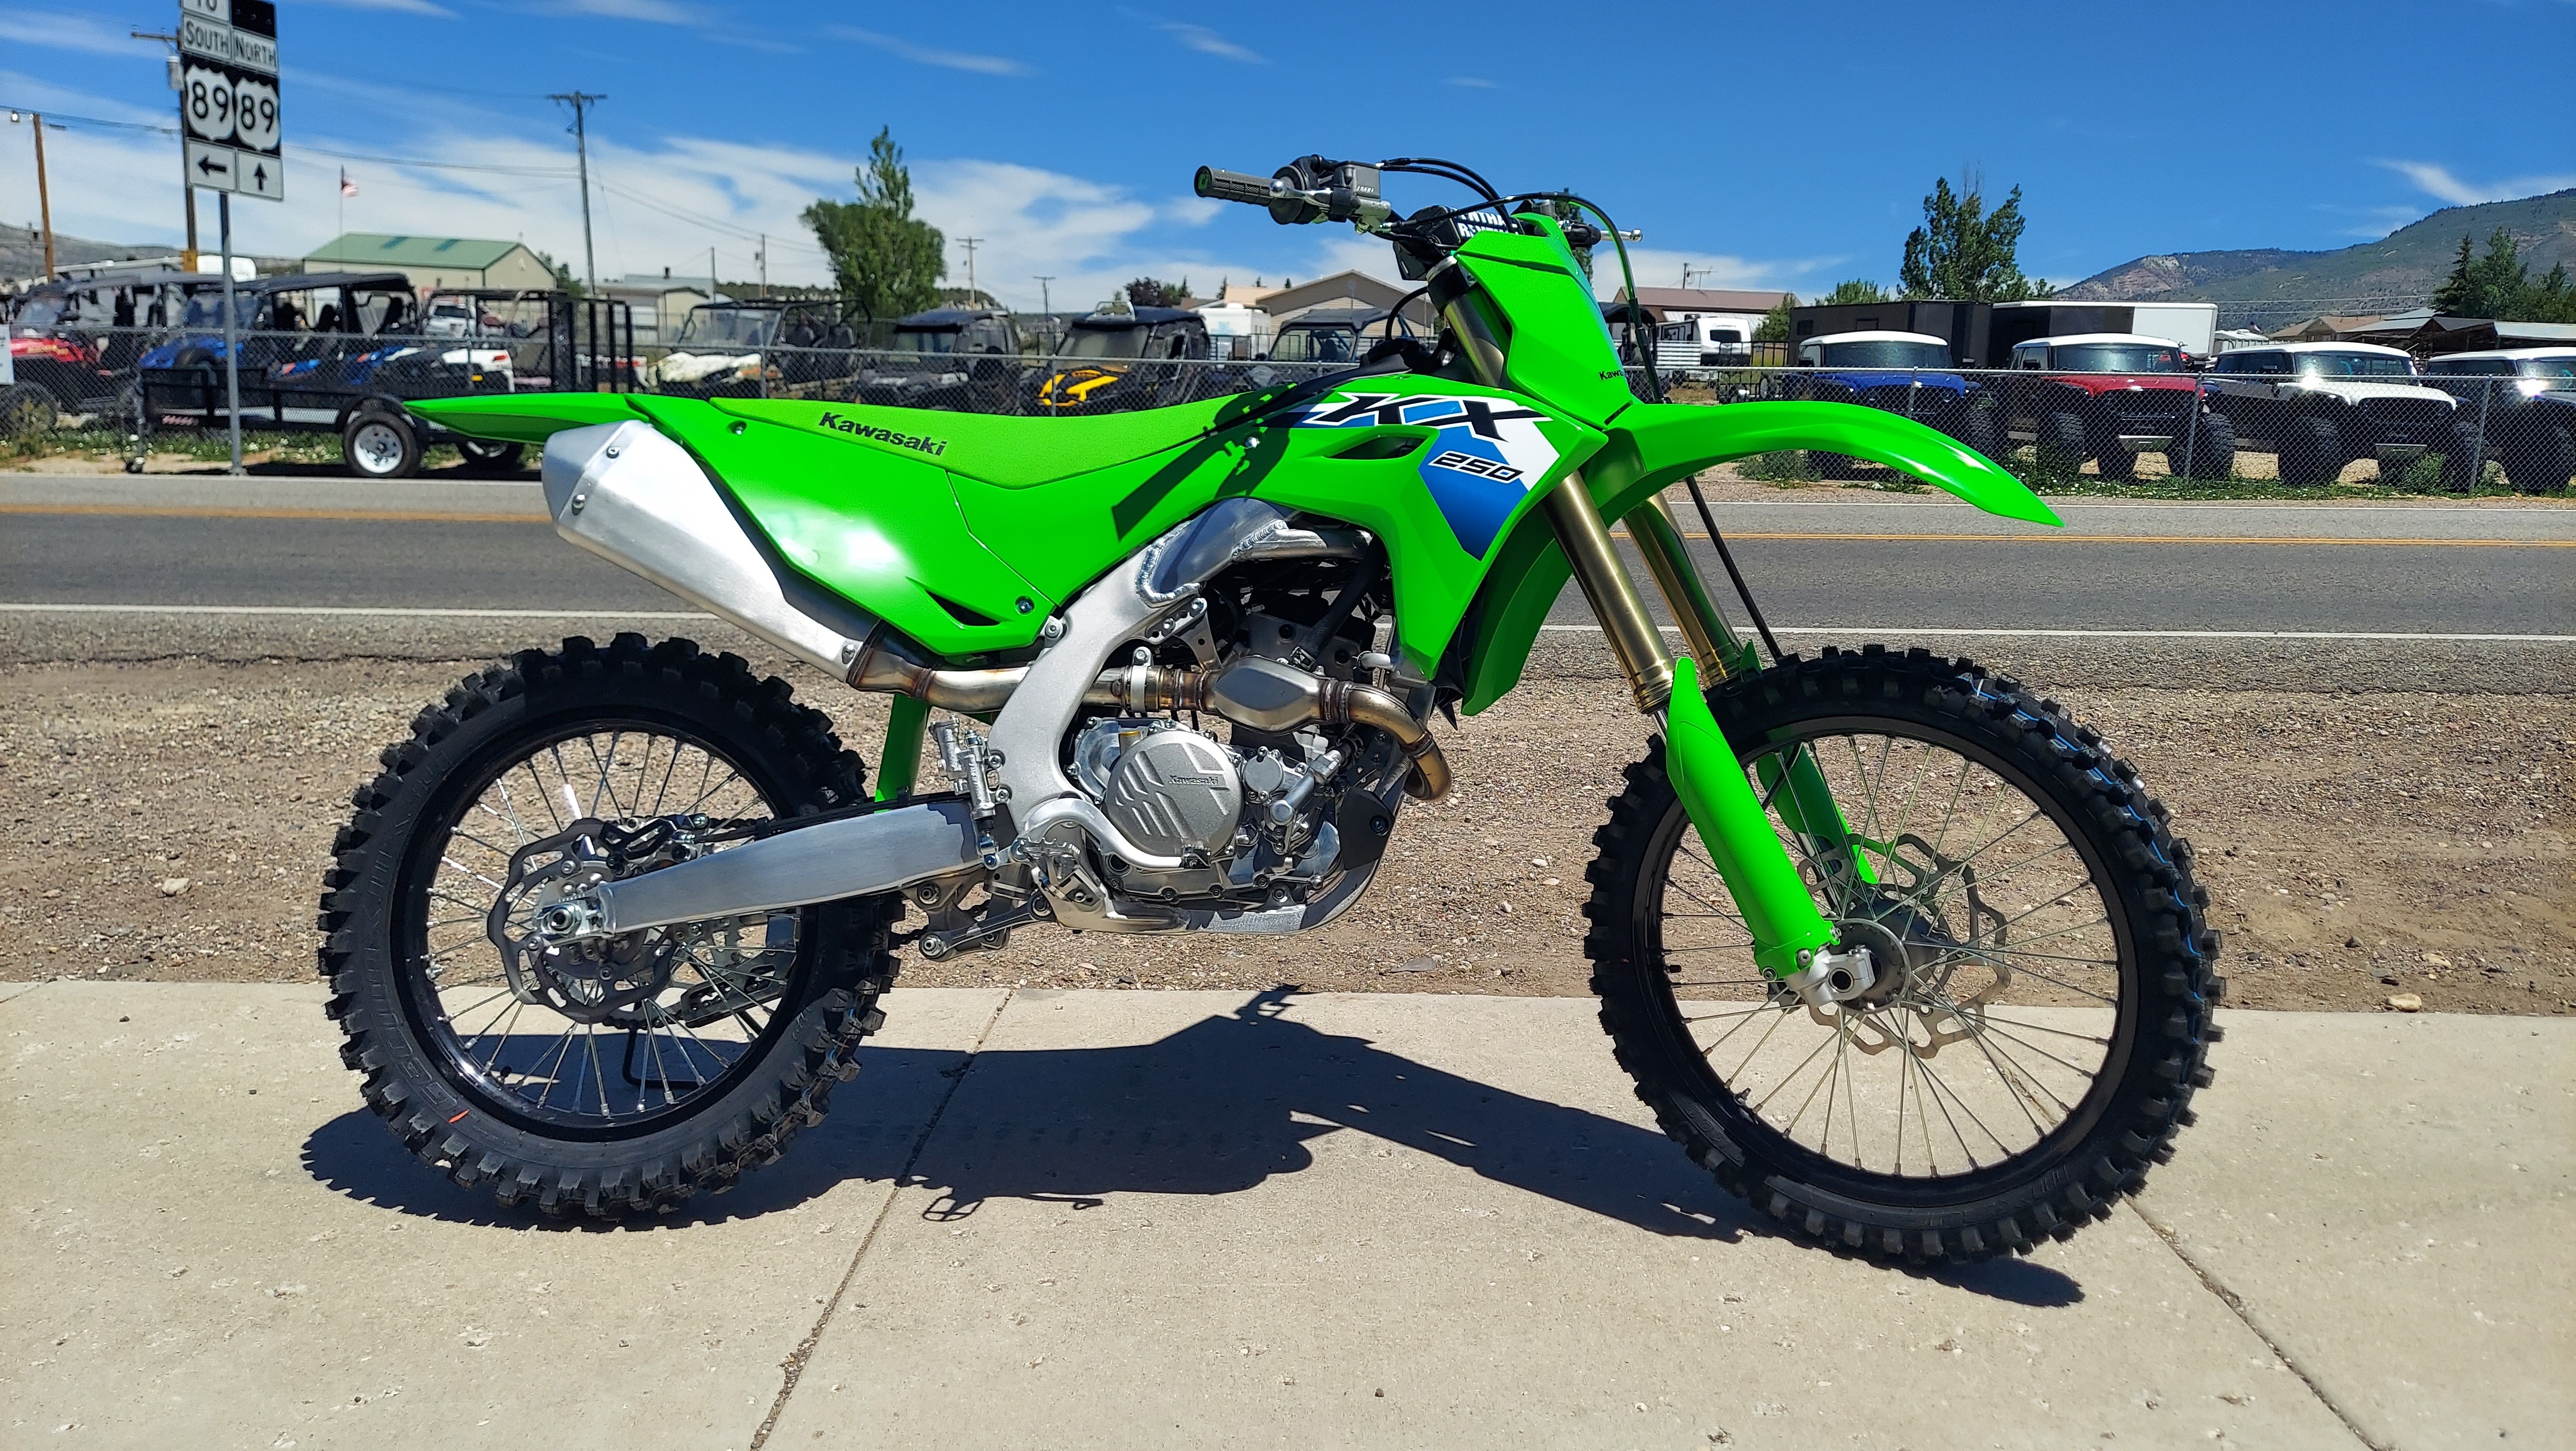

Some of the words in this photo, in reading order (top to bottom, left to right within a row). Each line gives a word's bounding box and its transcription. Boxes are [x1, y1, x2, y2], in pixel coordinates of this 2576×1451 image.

[186, 21, 229, 54] SOUTH
[236, 37, 276, 67] NORTH
[192, 82, 228, 122] 89
[241, 95, 274, 133] 89
[818, 412, 948, 456] Kawasaki
[1314, 394, 1551, 443] KX
[1430, 451, 1525, 483] 250
[1169, 775, 1218, 785] Kawasaki
